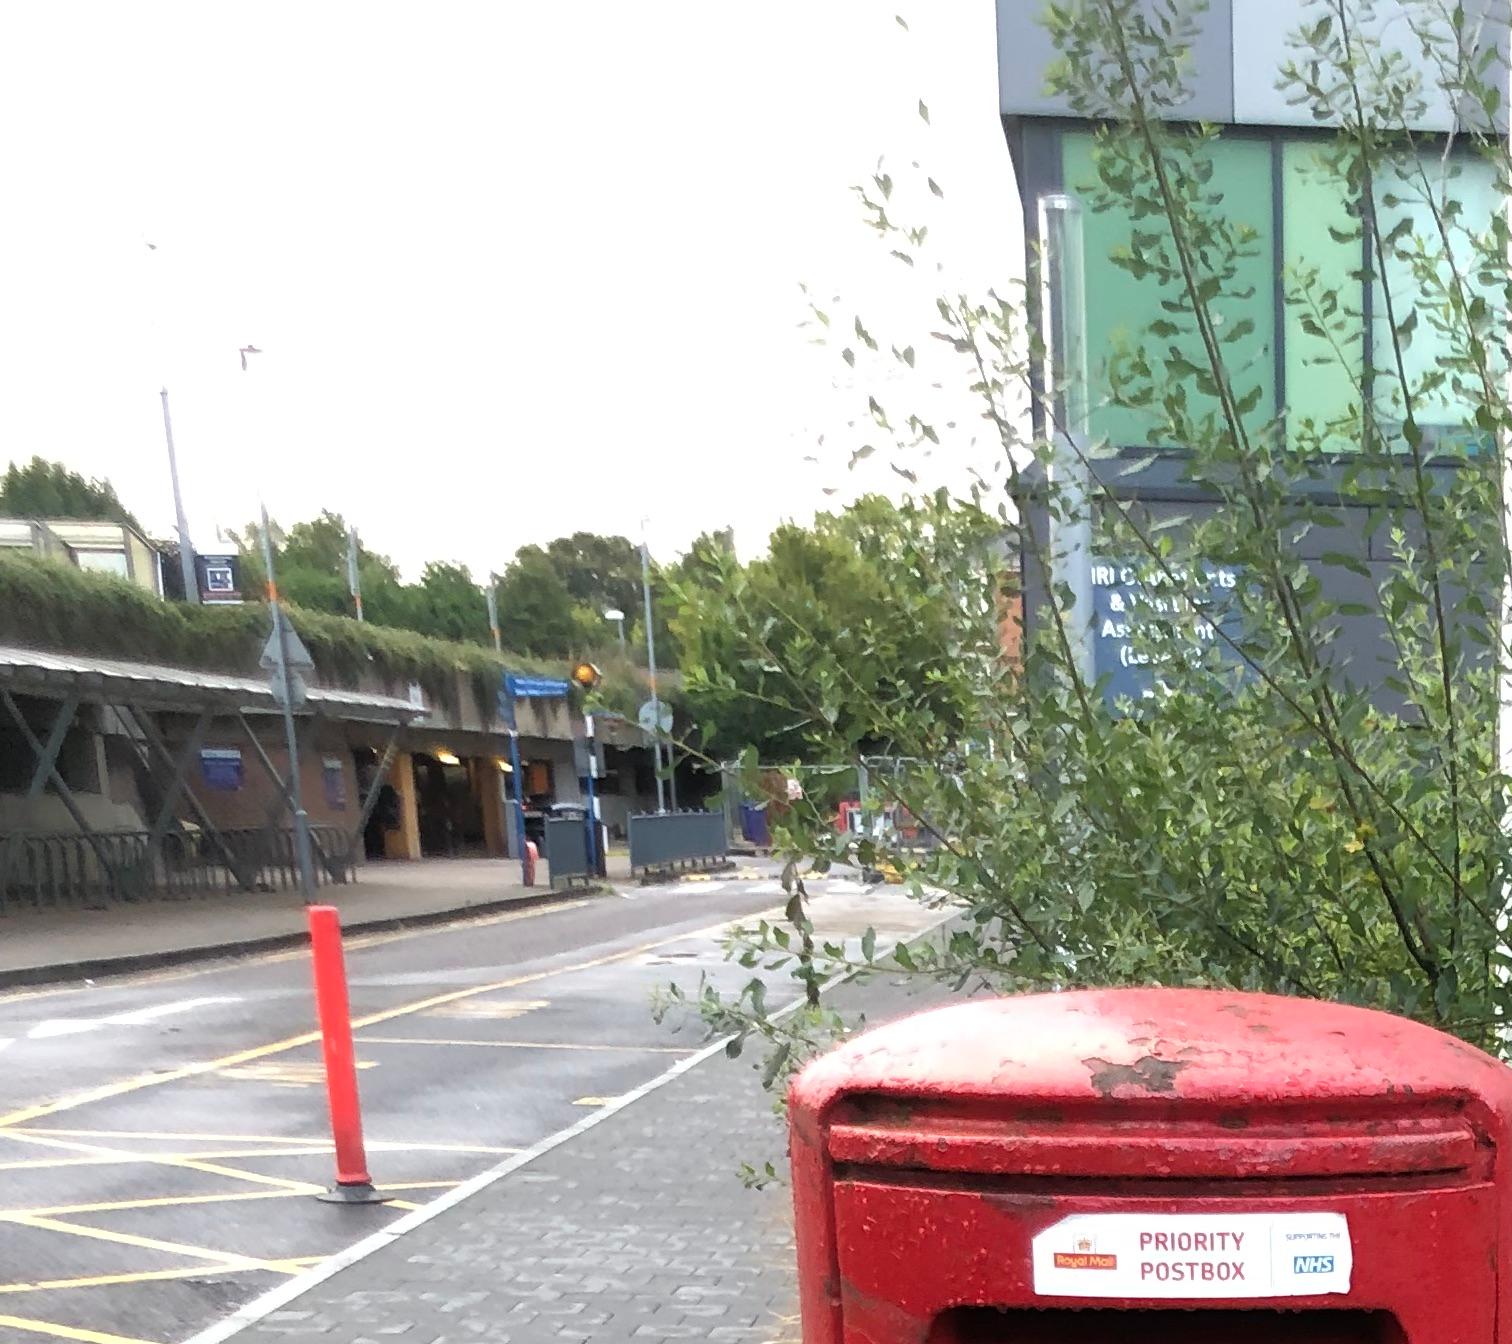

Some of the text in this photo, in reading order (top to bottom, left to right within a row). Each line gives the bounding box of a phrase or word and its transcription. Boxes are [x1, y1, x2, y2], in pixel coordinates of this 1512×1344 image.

[1110, 593, 1125, 612] &
[1139, 1232, 1245, 1251] PRIORITY
[1056, 1254, 1088, 1268] Royal
[1295, 1256, 1333, 1273] NHS
[1140, 1262, 1246, 1281] POSTBOX
